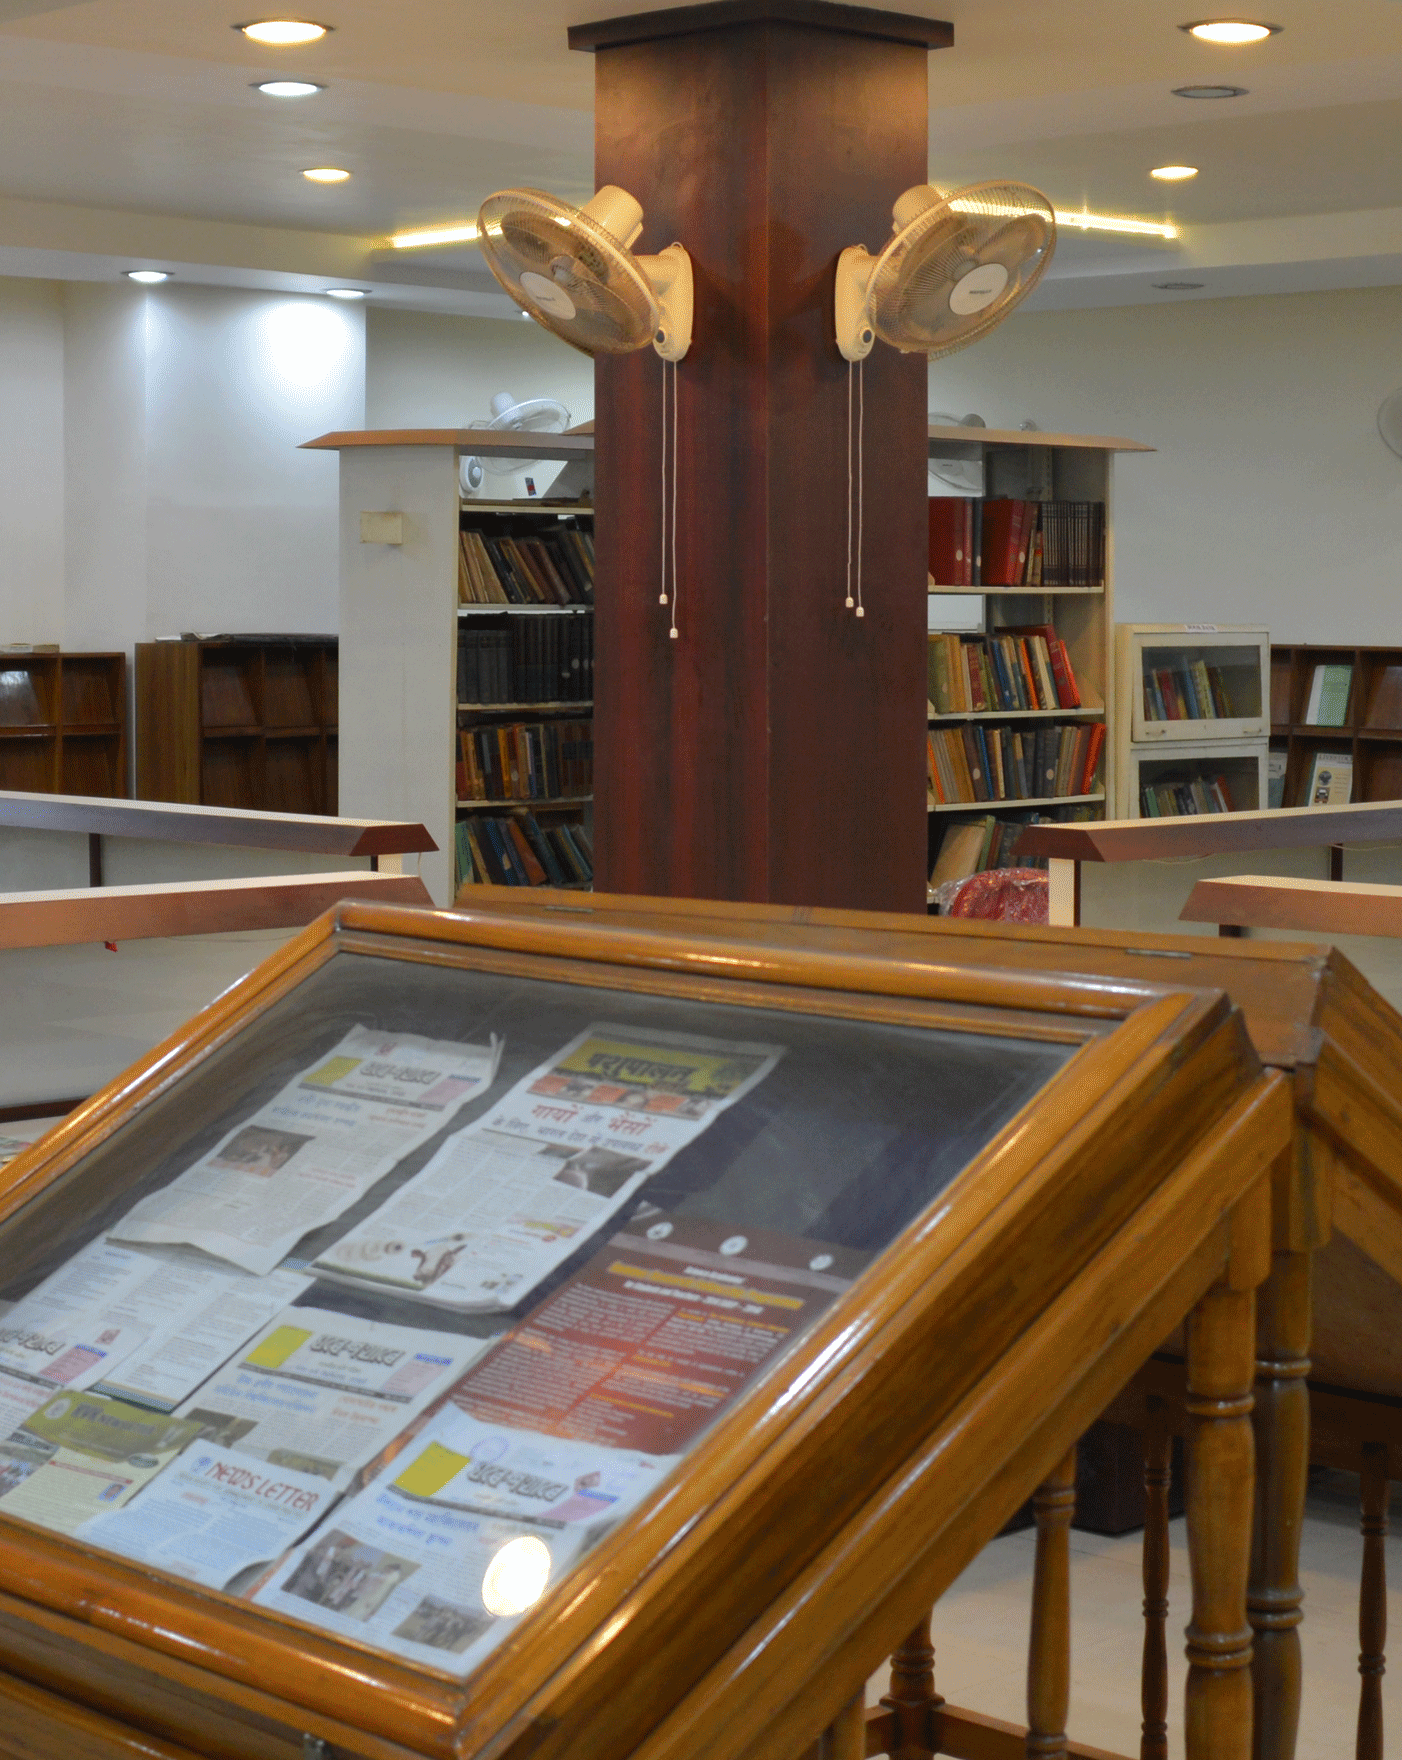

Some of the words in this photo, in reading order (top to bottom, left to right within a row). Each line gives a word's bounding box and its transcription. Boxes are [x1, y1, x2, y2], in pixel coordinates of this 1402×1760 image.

[588, 1053, 696, 1083] पशुपालन
[532, 1103, 580, 1124] गायों
[608, 1110, 655, 1133] भैंसों
[205, 1461, 261, 1491] NEWS
[255, 1479, 320, 1512] LETTER
